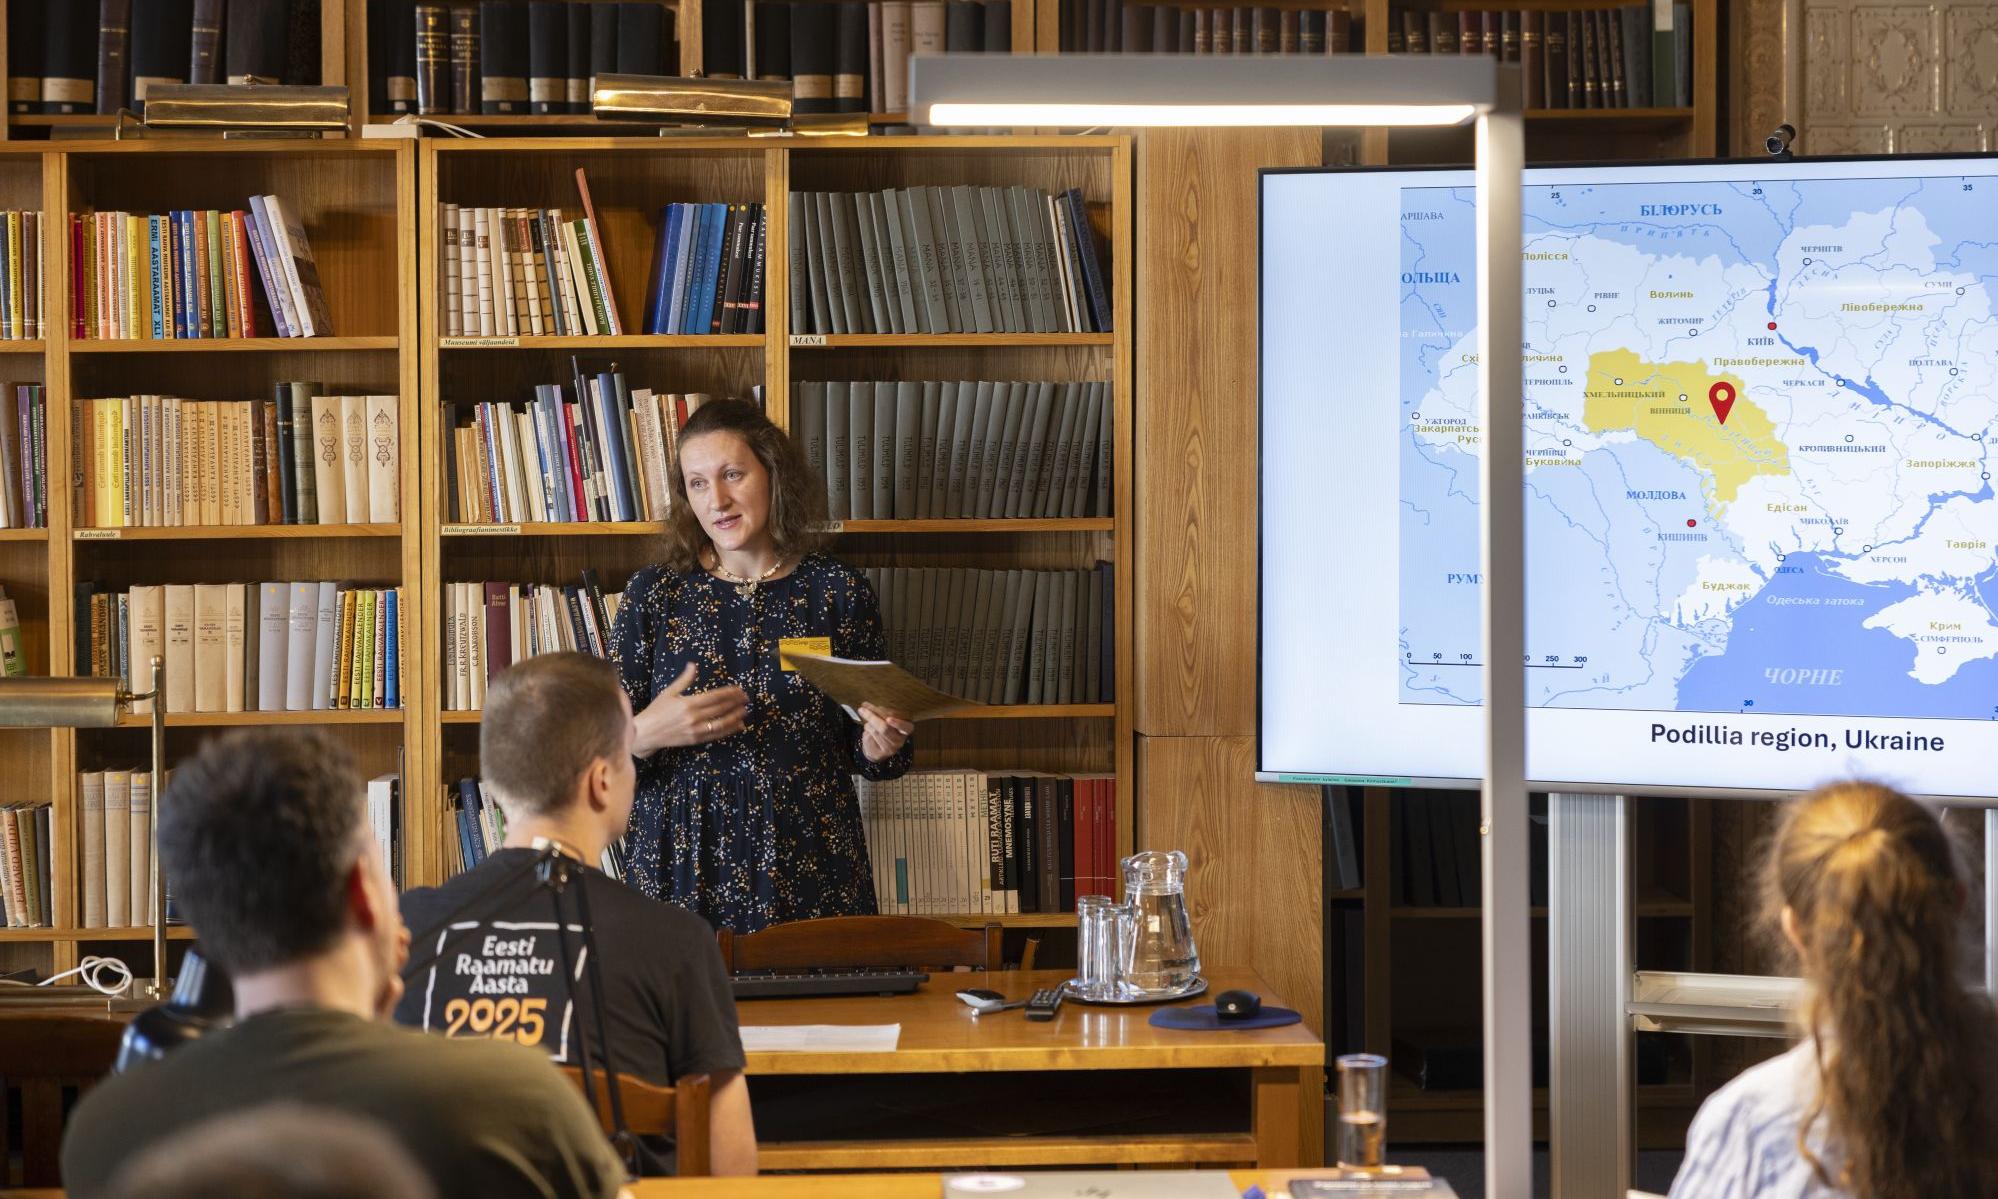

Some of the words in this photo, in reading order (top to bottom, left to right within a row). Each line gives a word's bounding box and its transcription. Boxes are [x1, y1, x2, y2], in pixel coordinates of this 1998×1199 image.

[1640, 204, 1722, 217] БІЛОРУСЬ
[151, 246, 161, 315] AASTARAAMAT
[1401, 272, 1461, 284] ОЛЬЩА
[1924, 281, 1953, 289] СУМИ
[163, 281, 171, 318] AASTARAAMAT
[1649, 290, 1694, 299] Волинь
[1840, 302, 1924, 313] Лівобережна
[1657, 317, 1705, 325] ЖИТОМИР
[153, 320, 162, 336] XLI
[792, 336, 823, 345] MANA
[1747, 337, 1775, 346] КИЇВ
[1713, 356, 1806, 368] Правобережна
[1908, 359, 1954, 367] ПОЛТАВА
[1782, 379, 1826, 388] ЧЕРКАСИ
[1582, 390, 1666, 399] ХМЕЛЬНИЦЬКИЙ
[1424, 418, 1467, 426] УЖГОРОД
[1798, 444, 1887, 453] КРОПИВНИЦЬКИЙ
[1525, 457, 1582, 467] Буковина
[1905, 459, 1977, 470] Запоріжжя
[1625, 490, 1687, 500] МОЛДОВА
[1766, 503, 1808, 513] Едісан
[1945, 540, 1987, 550] Таврія
[1870, 556, 1908, 564] ХЕРСОН
[1702, 581, 1751, 592] Буджак
[1766, 595, 1820, 605] Одеська
[1823, 596, 1866, 606] затока
[1929, 621, 1962, 632] Крим
[343, 602, 352, 663] RAHVAKALENDER
[355, 603, 363, 664] RAHVAKALENDER
[1459, 653, 1473, 661] 100
[1764, 668, 1844, 686] ЧОРНЕ
[1650, 723, 1743, 746] Podillia
[1750, 727, 1838, 752] region,
[1844, 728, 1945, 752] Ukraine
[979, 788, 988, 818] METHIS
[988, 791, 999, 838] RAAMAT
[1002, 798, 1014, 859] MNEMOSYNE
[7, 819, 18, 855] VILDE
[990, 839, 1000, 863] RUTI
[12, 856, 25, 904] EDUARD
[481, 935, 537, 957] Eesti
[454, 953, 555, 976] Raamatu
[468, 975, 529, 995] Aasta
[444, 997, 548, 1047] 2025
